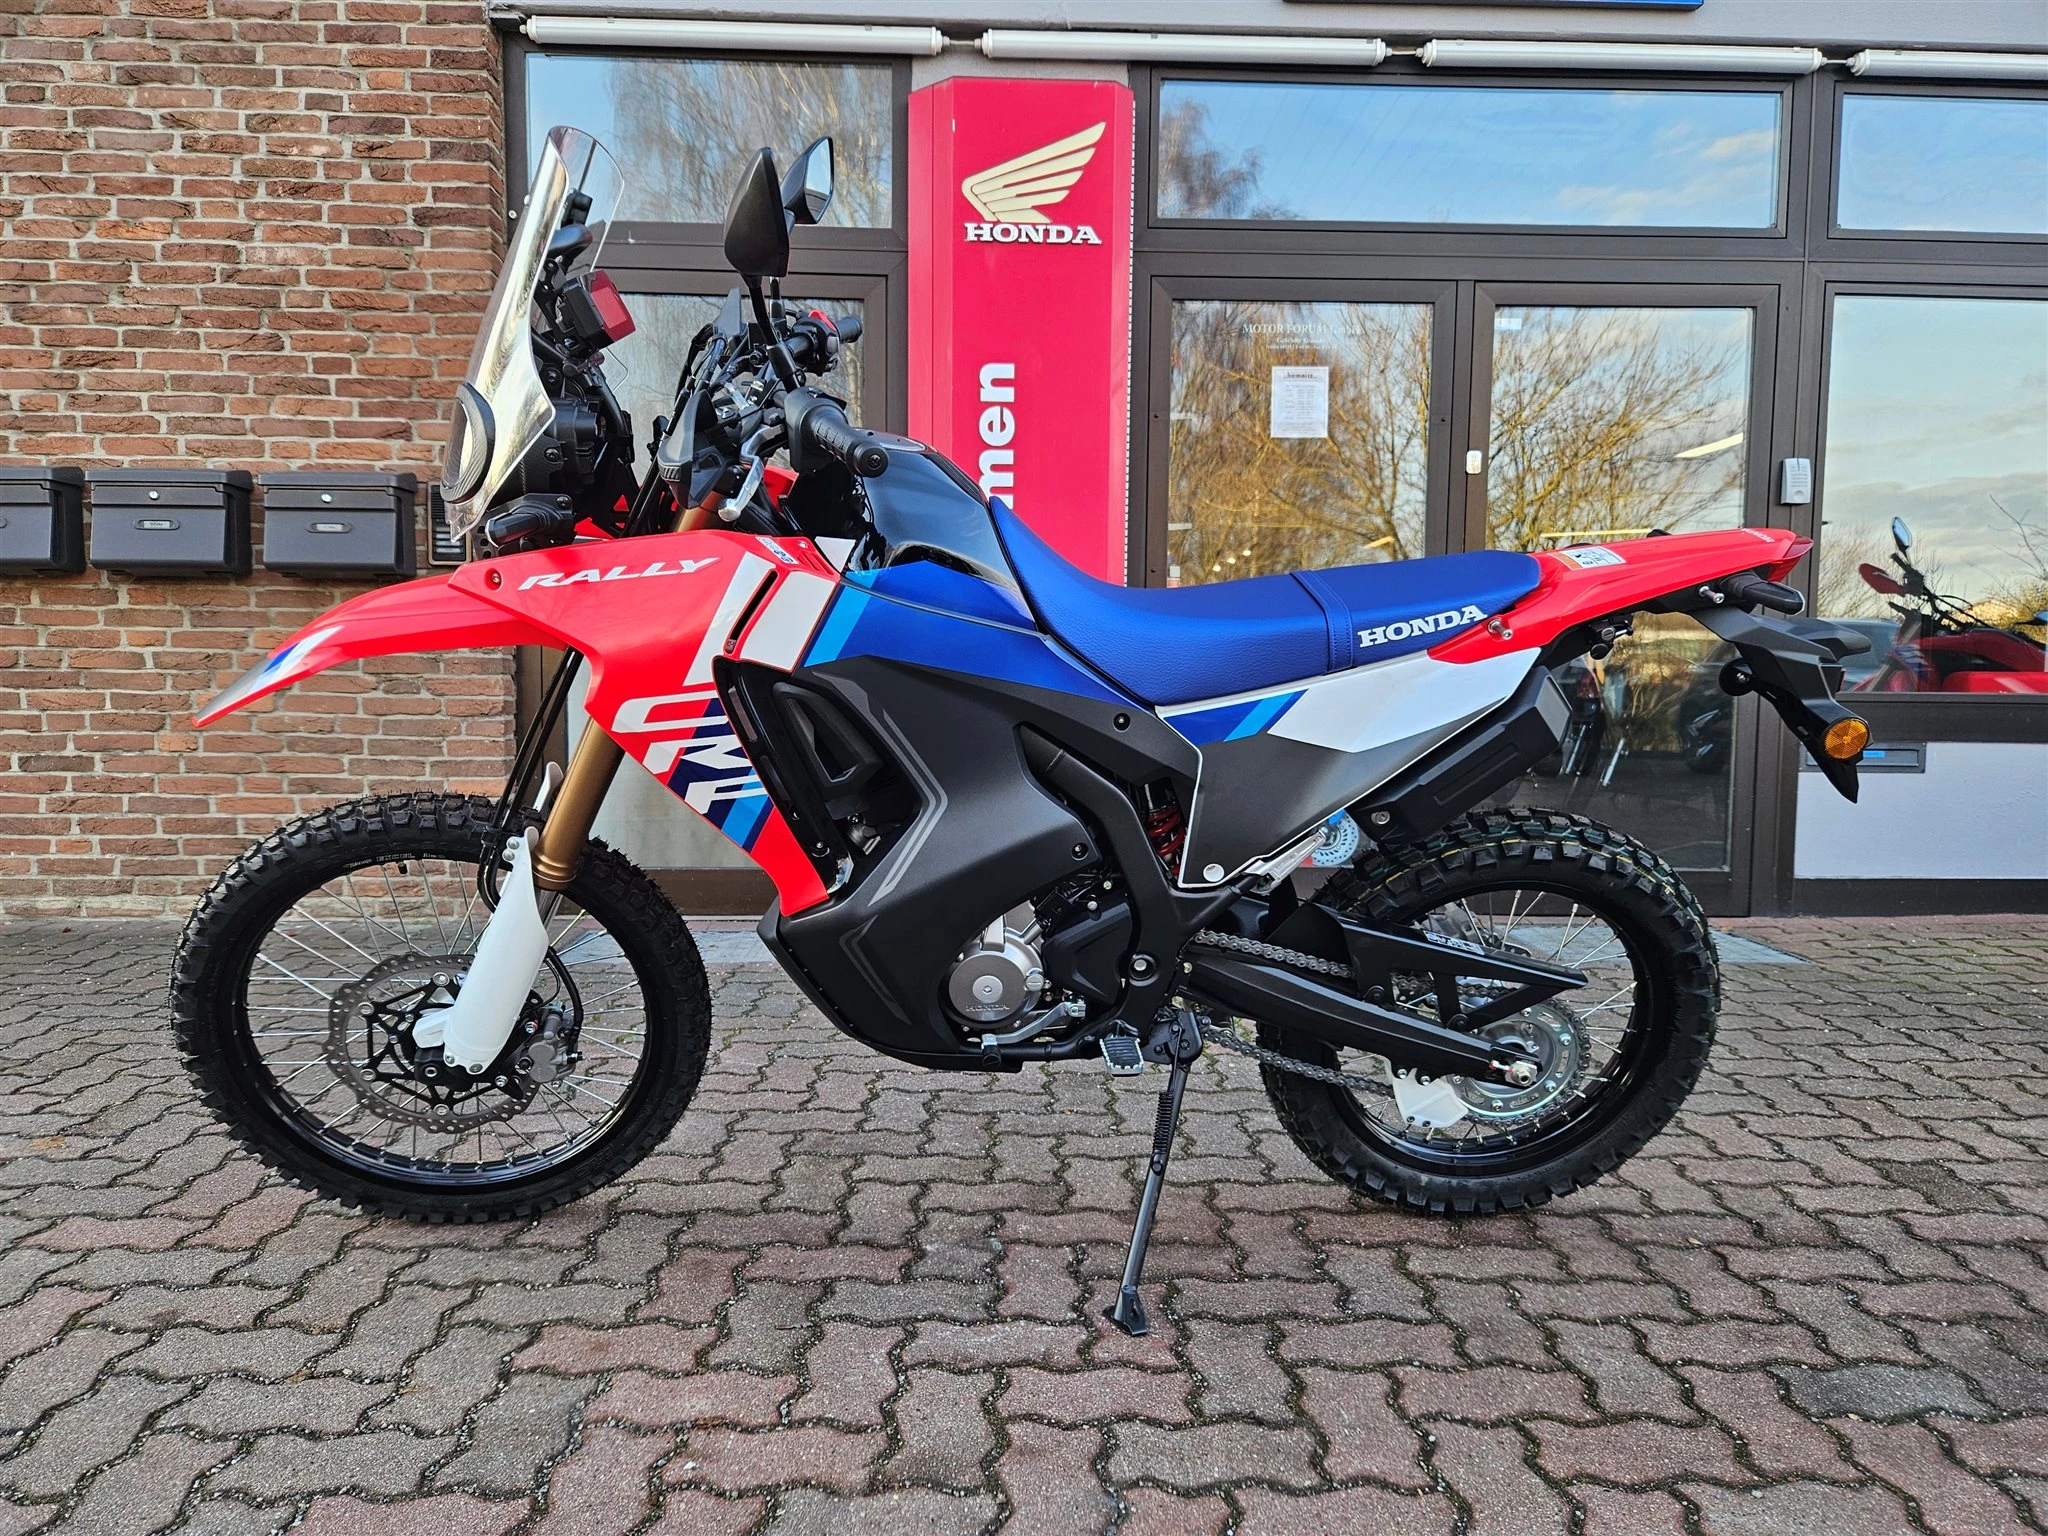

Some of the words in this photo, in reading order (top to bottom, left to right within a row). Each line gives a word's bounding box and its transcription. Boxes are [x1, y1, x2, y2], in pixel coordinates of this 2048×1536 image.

[964, 223, 1102, 244] HONDA
[1242, 323, 1284, 333] MOTOR
[1287, 323, 1327, 334] FORUM
[517, 557, 720, 591] RALLY
[1357, 605, 1488, 648] HONDA
[611, 689, 769, 815] CRF
[965, 1004, 1010, 1012] HONDA
